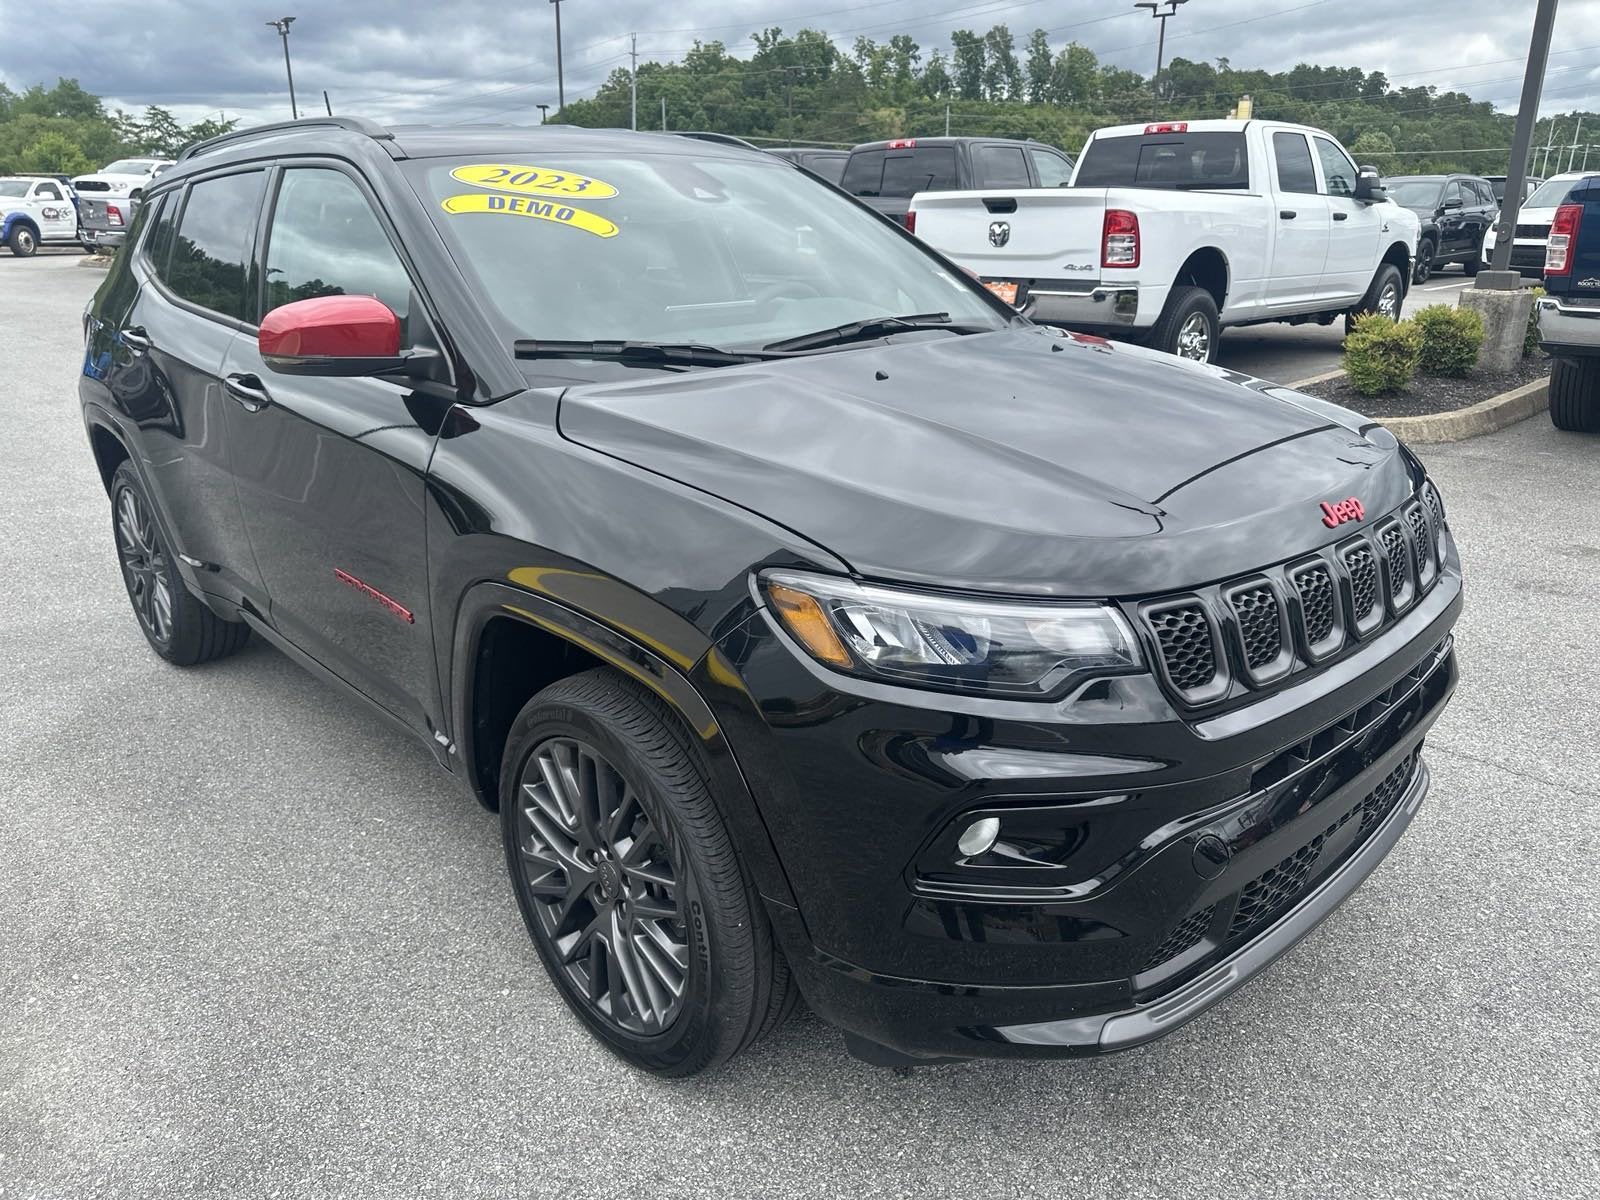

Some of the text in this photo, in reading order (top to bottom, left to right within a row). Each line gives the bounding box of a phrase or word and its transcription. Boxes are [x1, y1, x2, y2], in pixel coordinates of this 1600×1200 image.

[479, 169, 592, 193] 2023
[488, 196, 576, 222] DEMO
[1319, 496, 1365, 529] Jeep
